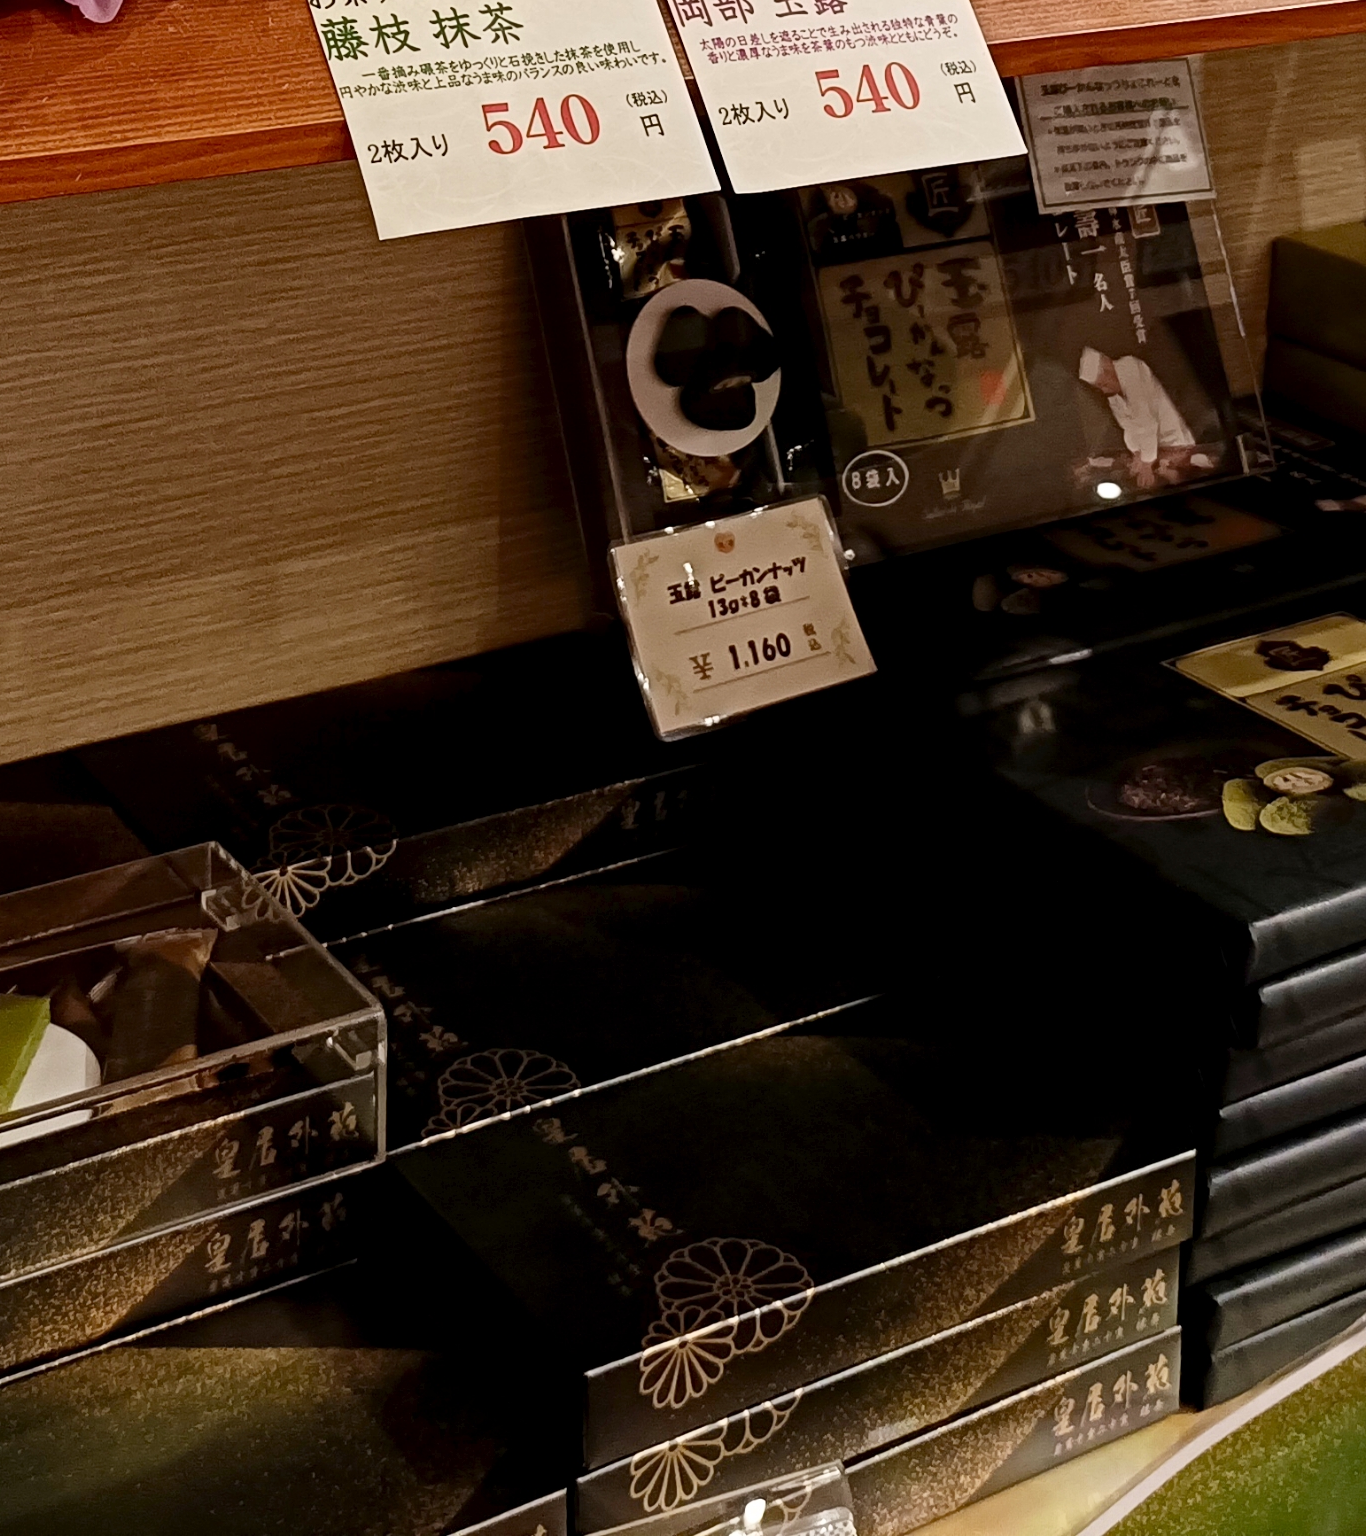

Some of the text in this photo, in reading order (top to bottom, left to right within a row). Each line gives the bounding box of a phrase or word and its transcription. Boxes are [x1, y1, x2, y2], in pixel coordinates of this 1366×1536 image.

[321, 2, 525, 61] 藤枝 抹茶
[940, 60, 978, 77] (税込)
[625, 89, 669, 109] (税込)
[718, 61, 921, 126] 2枚入り 540
[954, 82, 977, 105] 円
[367, 93, 601, 165] 2枚入り 540
[640, 113, 666, 138] 円
[1093, 272, 1115, 312] 名人
[839, 274, 903, 431] チョコレート
[850, 467, 901, 490] 8袋入
[710, 557, 806, 595] ピーカンナッツ
[689, 652, 714, 681] ¥
[213, 1102, 359, 1179] 皇居外苑
[1061, 1179, 1184, 1254] 皇居外苑
[1047, 1268, 1167, 1345] 皇居外苑
[1053, 1353, 1171, 1436] 皇居外苑
